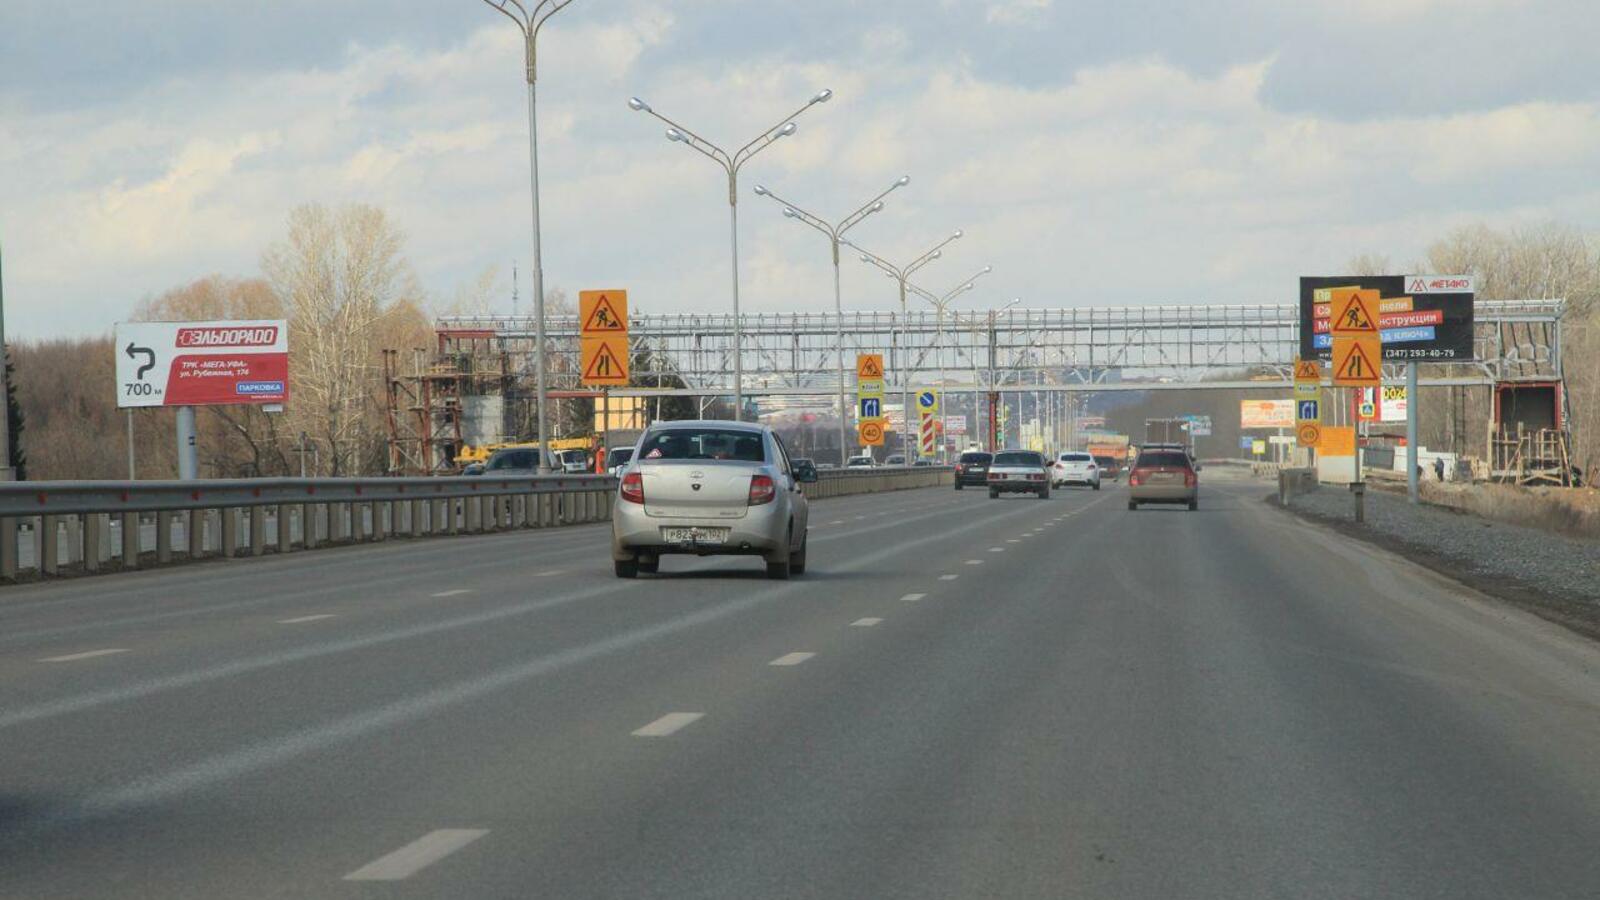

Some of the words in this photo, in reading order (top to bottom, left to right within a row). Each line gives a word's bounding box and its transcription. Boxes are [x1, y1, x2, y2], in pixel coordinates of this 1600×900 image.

[1380, 314, 1437, 326] нструкции
[1386, 350, 1408, 358] (347)
[1410, 349, 1455, 357] 293-40-79
[125, 383, 152, 396] 700
[239, 383, 281, 391] ПАРКОВКА
